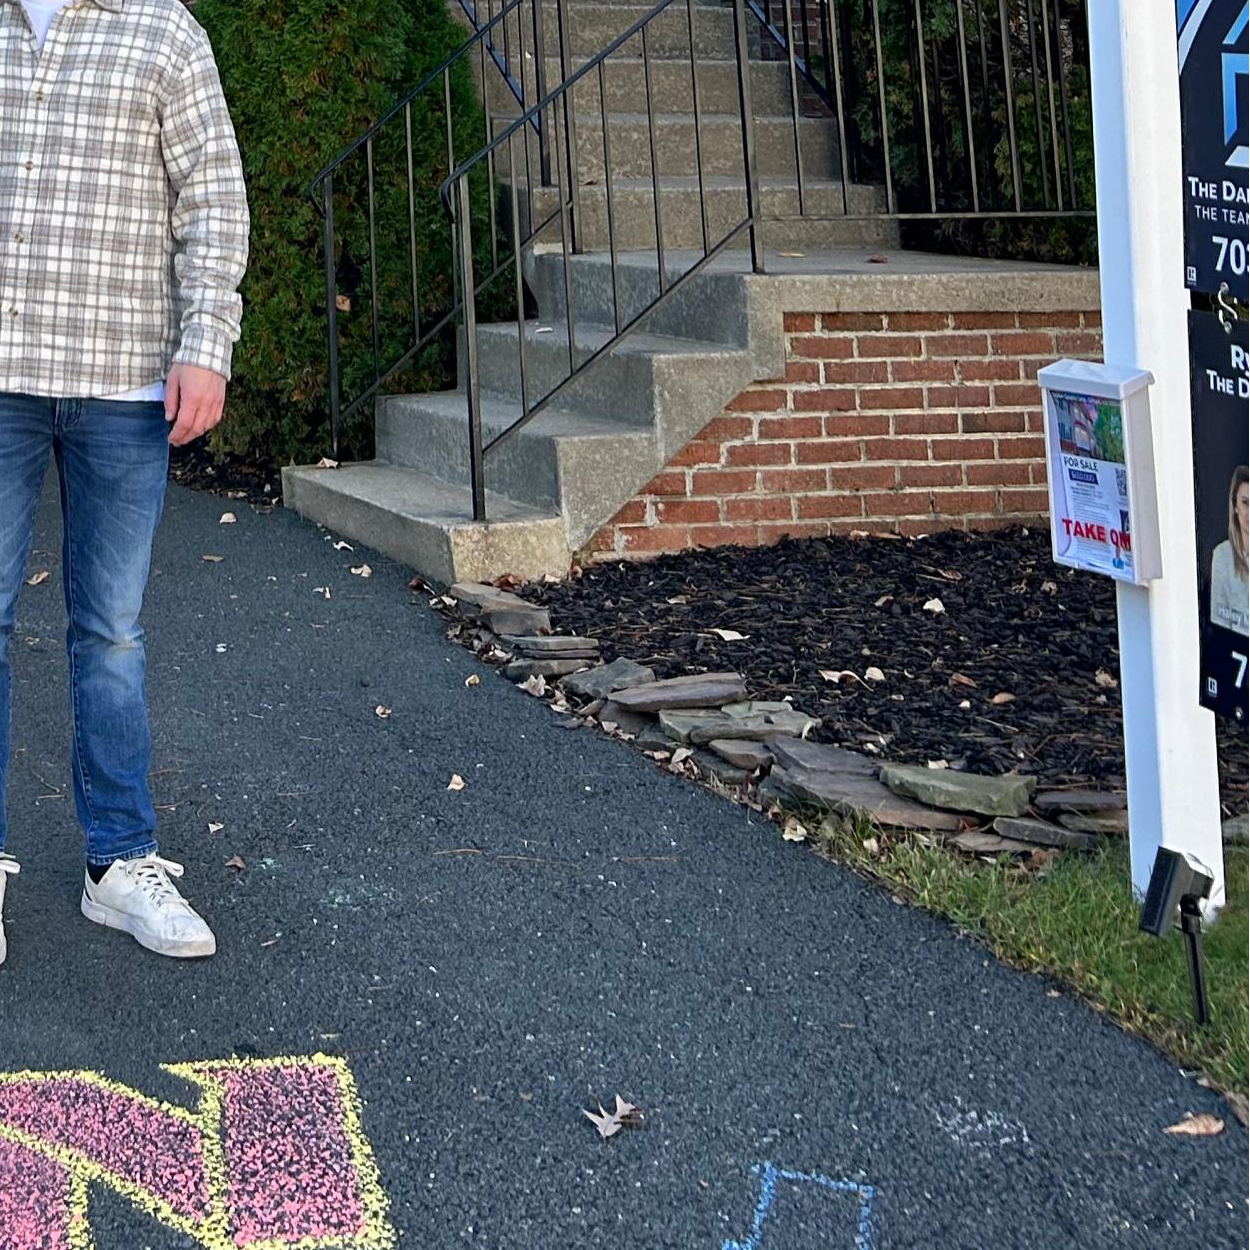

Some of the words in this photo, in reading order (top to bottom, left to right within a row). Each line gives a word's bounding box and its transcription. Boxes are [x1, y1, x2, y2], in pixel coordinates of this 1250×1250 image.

[1222, 180, 1249, 204] DA
[1194, 205, 1218, 221] THE
[1212, 235, 1249, 275] 70
[1063, 456, 1080, 468] FOR
[1080, 460, 1099, 472] SALE
[1062, 518, 1106, 543] TAKE
